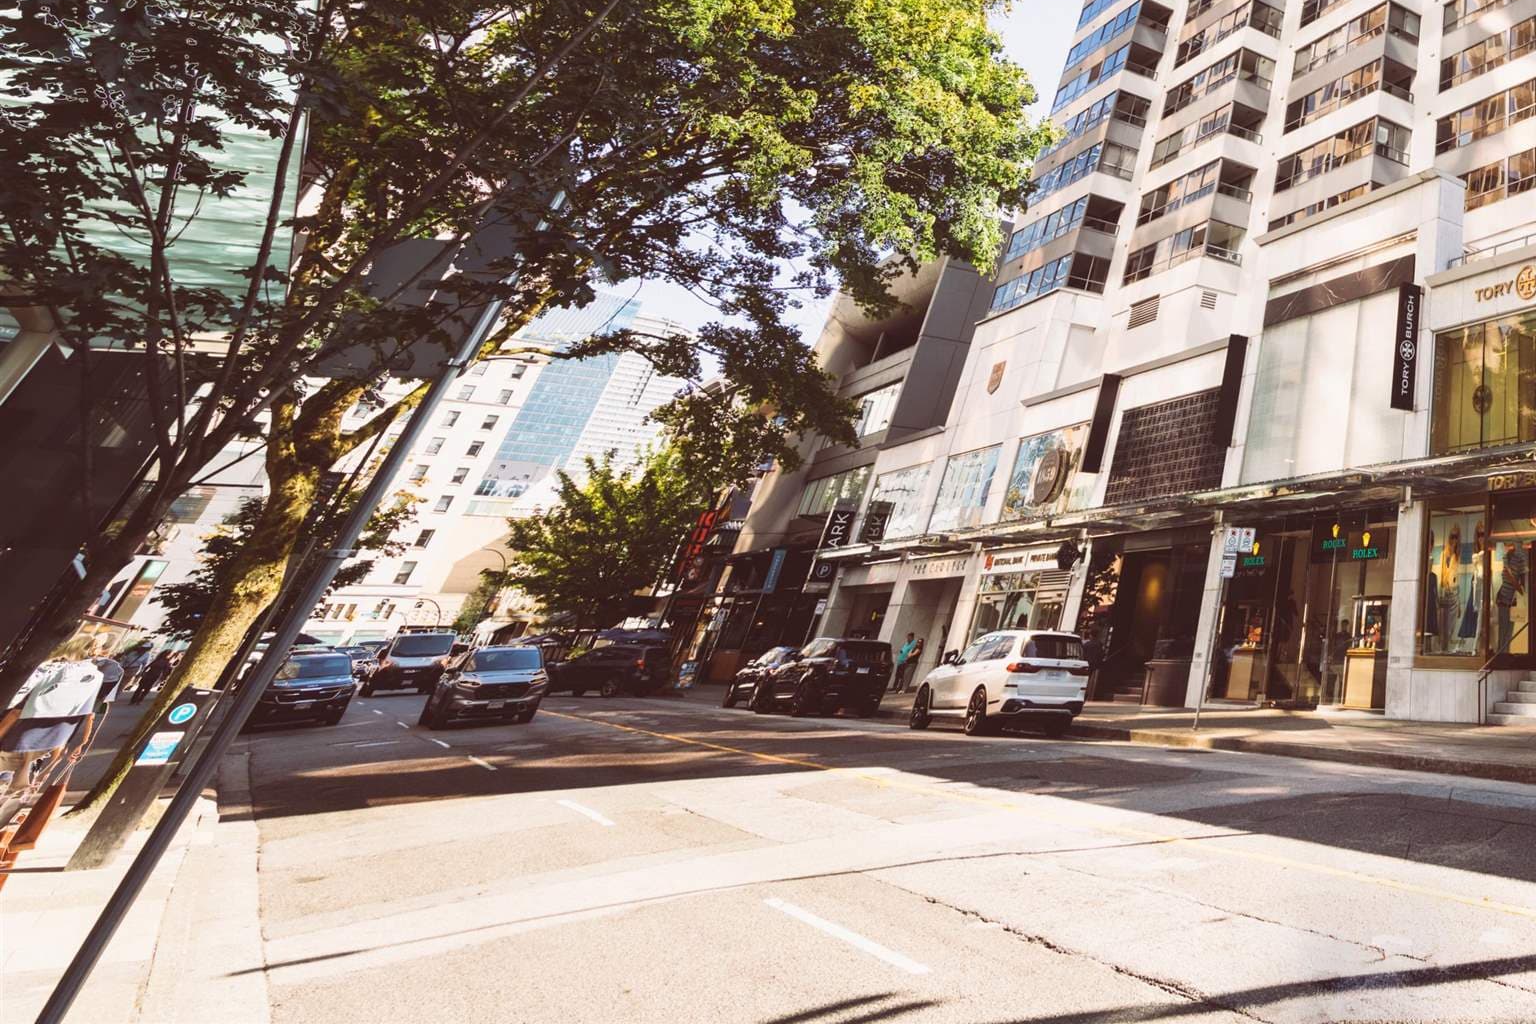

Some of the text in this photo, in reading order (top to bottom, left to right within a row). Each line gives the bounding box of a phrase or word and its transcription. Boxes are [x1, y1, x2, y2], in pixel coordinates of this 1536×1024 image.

[1474, 279, 1514, 303] TORY
[1400, 294, 1415, 396] TORY BURCH
[827, 512, 850, 550] ARK
[1243, 556, 1265, 567] ROLEX
[1352, 547, 1378, 560] ROLEX
[174, 706, 192, 721] P
